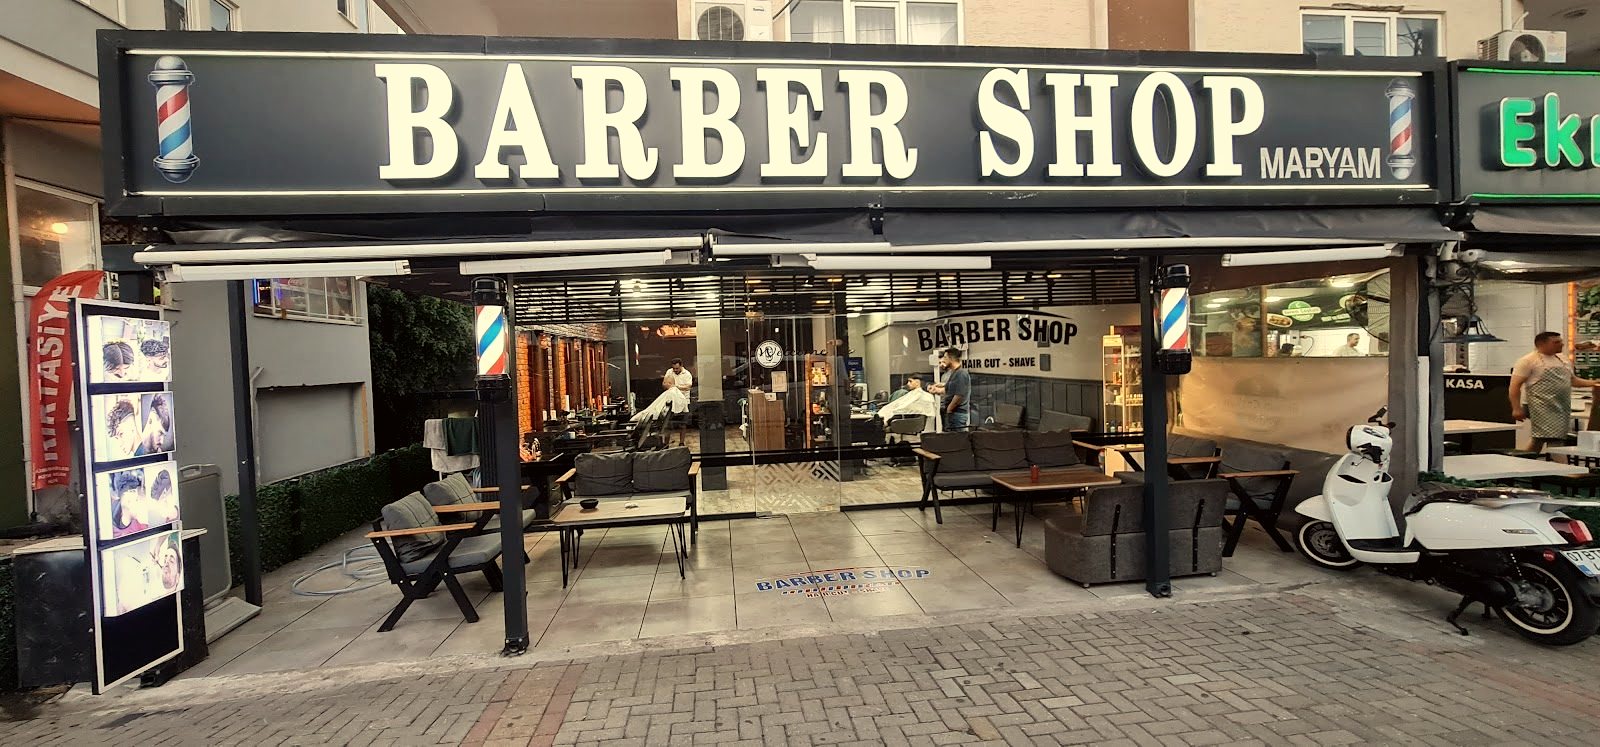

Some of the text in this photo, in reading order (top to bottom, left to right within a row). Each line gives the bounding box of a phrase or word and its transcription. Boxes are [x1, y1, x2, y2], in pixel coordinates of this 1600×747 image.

[374, 63, 1266, 181] BARBER SHOP
[1260, 147, 1381, 179] MARYAM
[917, 317, 1078, 352] BARBER SHOP
[961, 359, 982, 369] HAIR
[984, 358, 1001, 368] CUT
[1009, 357, 1036, 367] SHAVE
[1445, 379, 1485, 390] KASA
[756, 569, 931, 591] BARBER SHOP
